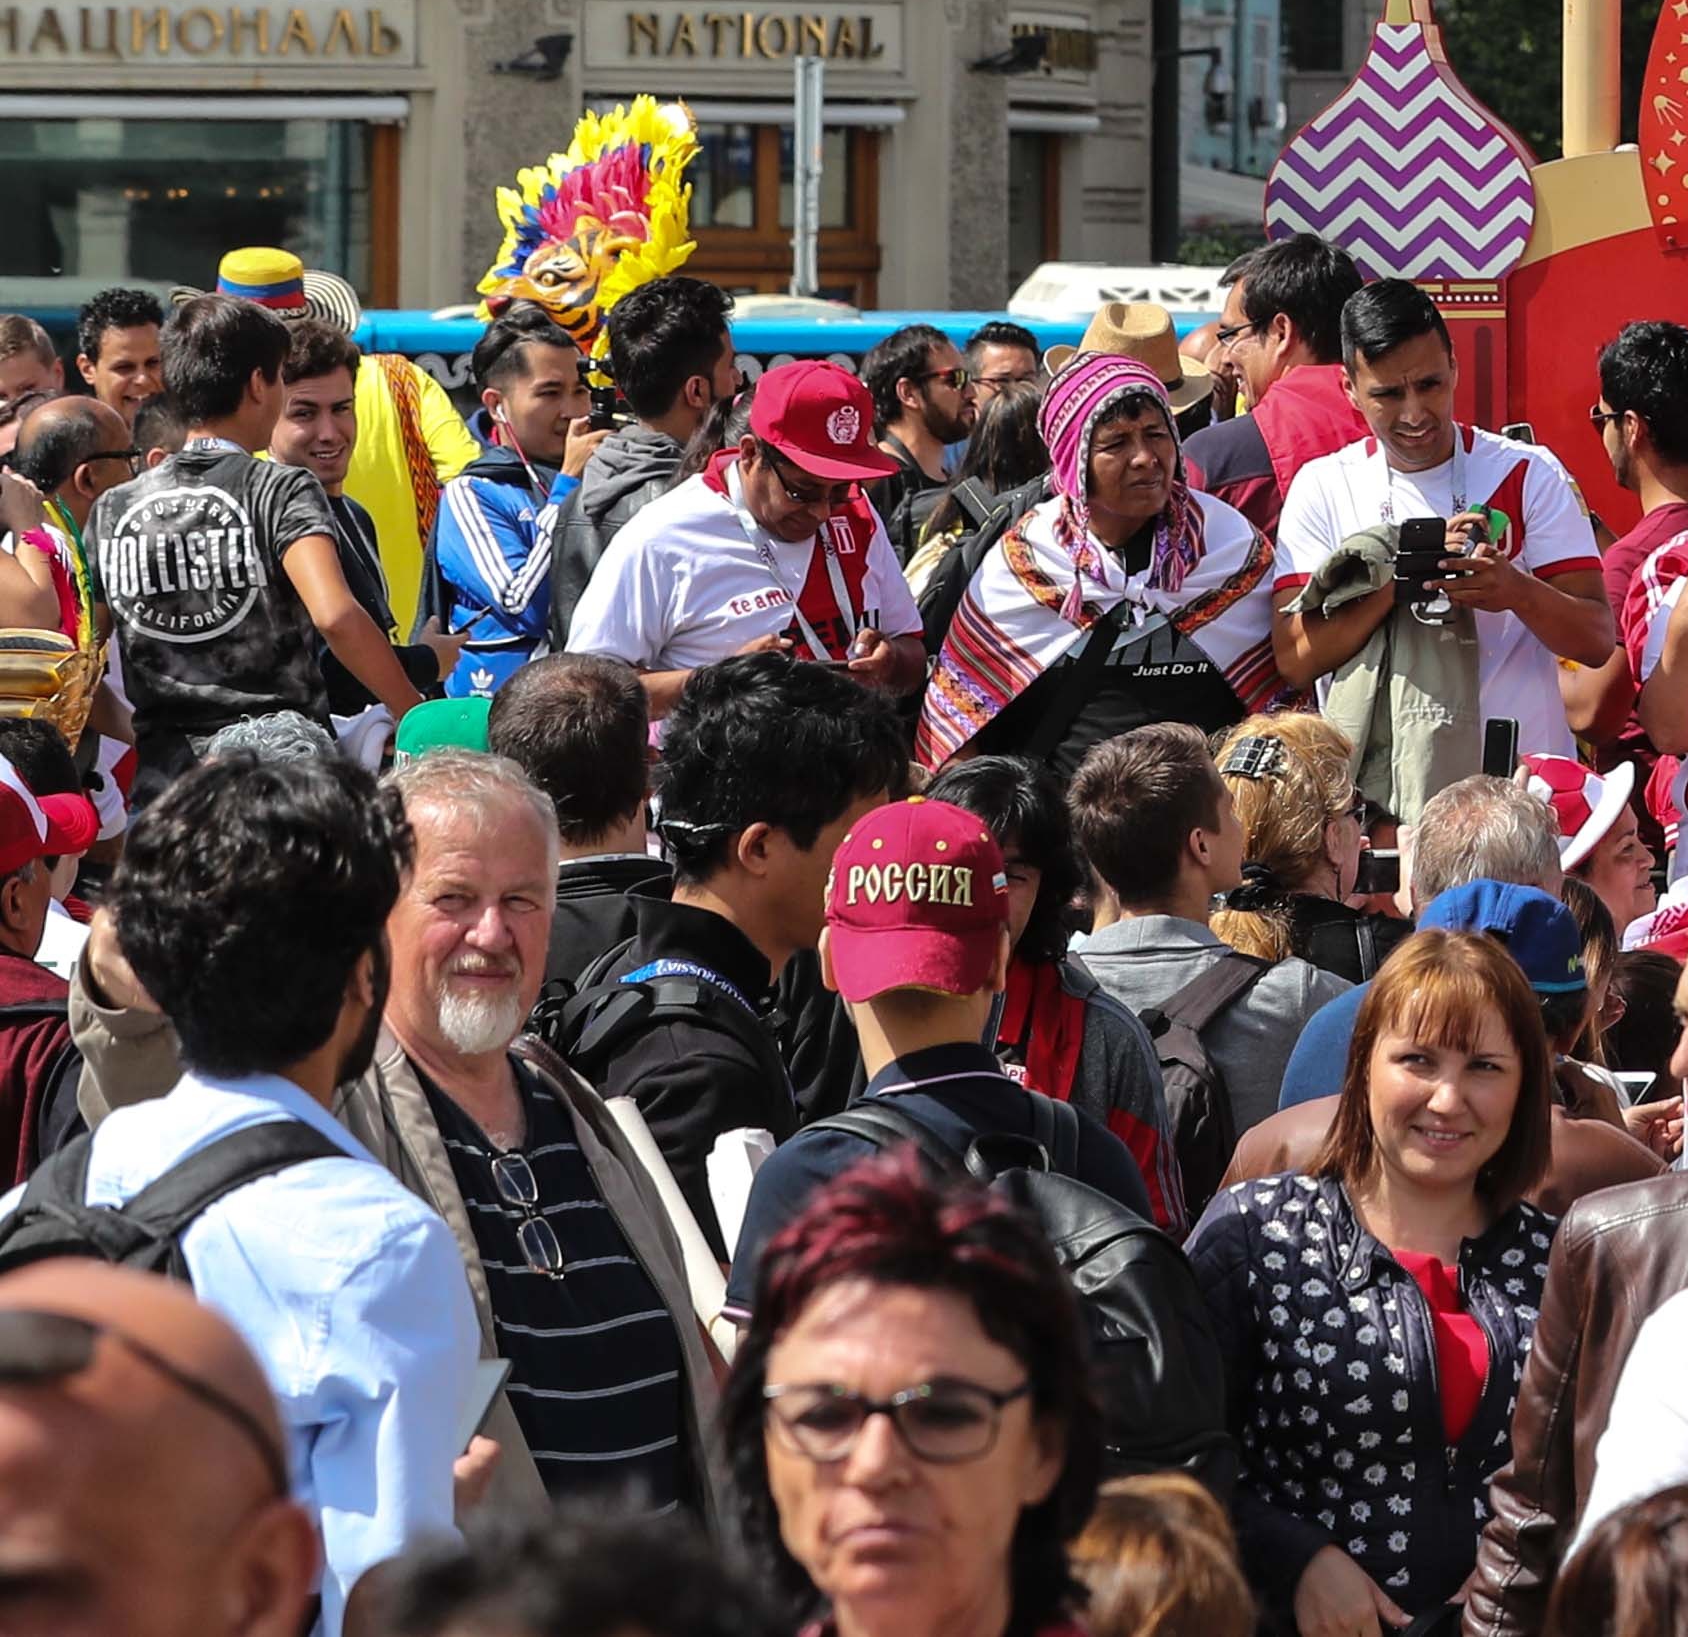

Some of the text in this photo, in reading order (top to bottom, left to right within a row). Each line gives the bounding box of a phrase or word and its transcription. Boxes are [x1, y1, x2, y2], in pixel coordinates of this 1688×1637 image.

[626, 12, 885, 60] NATIONAL
[130, 498, 233, 532] SOUTHERN
[99, 526, 268, 599] HOLLISTER
[134, 593, 239, 629] CALIFORNIA
[729, 599, 751, 616] te
[1132, 662, 1209, 676] Just Do It
[846, 863, 974, 907] РОССИЯ
